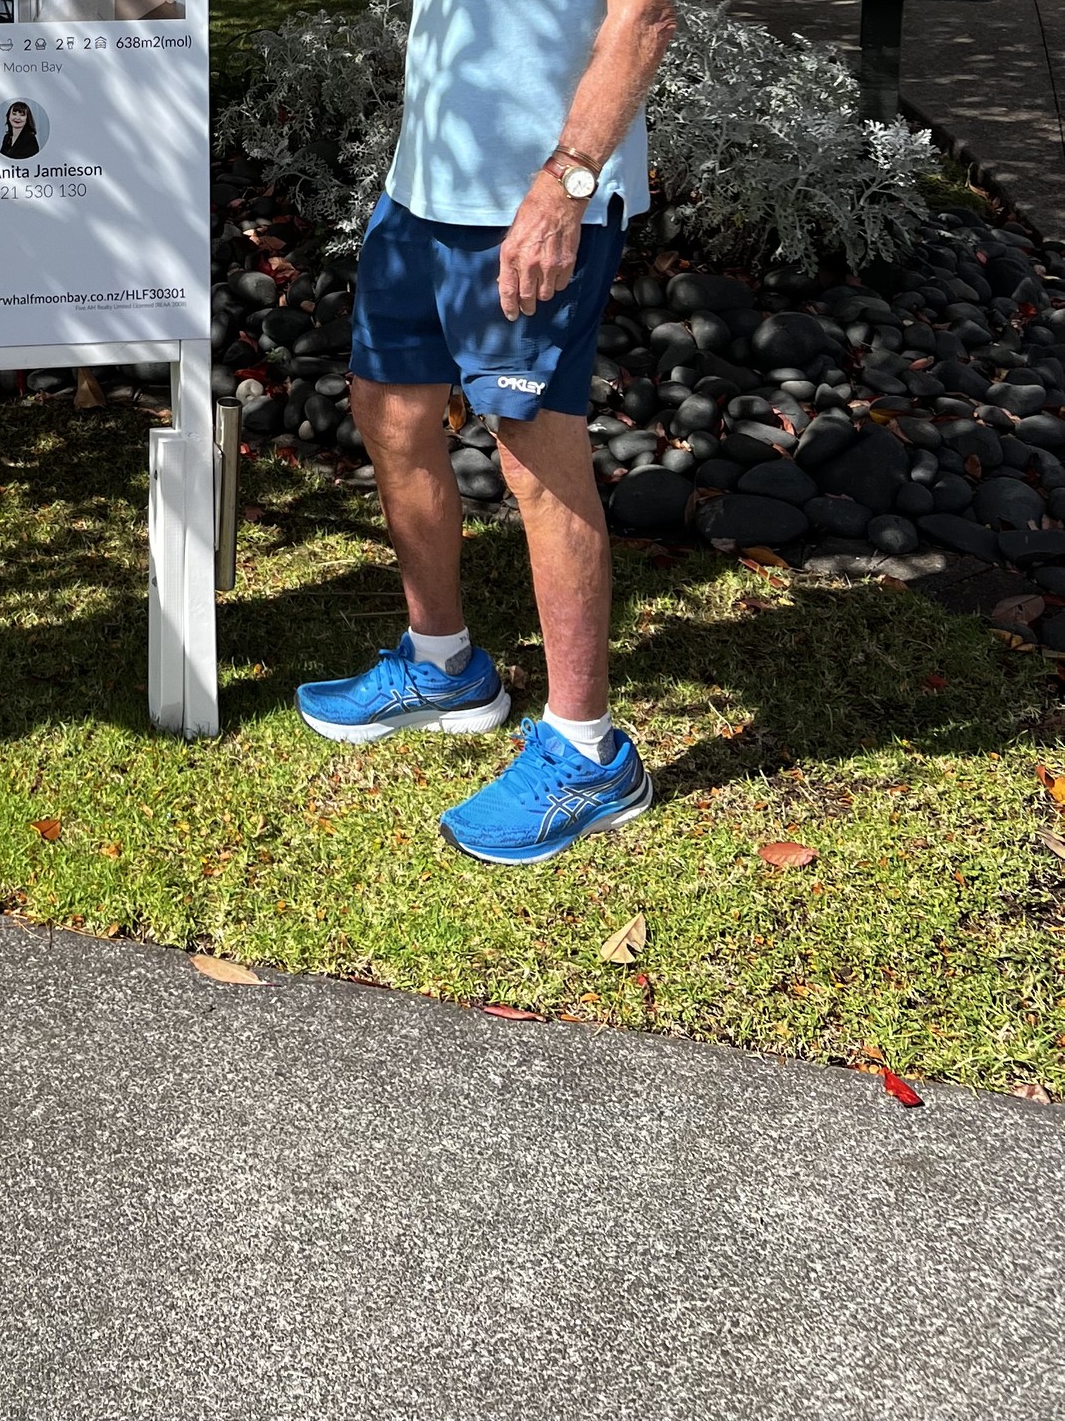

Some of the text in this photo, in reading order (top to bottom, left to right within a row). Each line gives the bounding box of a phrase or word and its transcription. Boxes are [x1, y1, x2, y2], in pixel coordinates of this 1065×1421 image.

[23, 39, 32, 51] 2
[55, 39, 64, 50] 2
[83, 38, 92, 50] 2
[115, 35, 192, 49] 638m2(mol)
[3, 61, 37, 73] Moon
[41, 60, 62, 74] Bay
[34, 162, 102, 176] Jamieson
[25, 185, 53, 198] 530
[59, 184, 86, 197] 130
